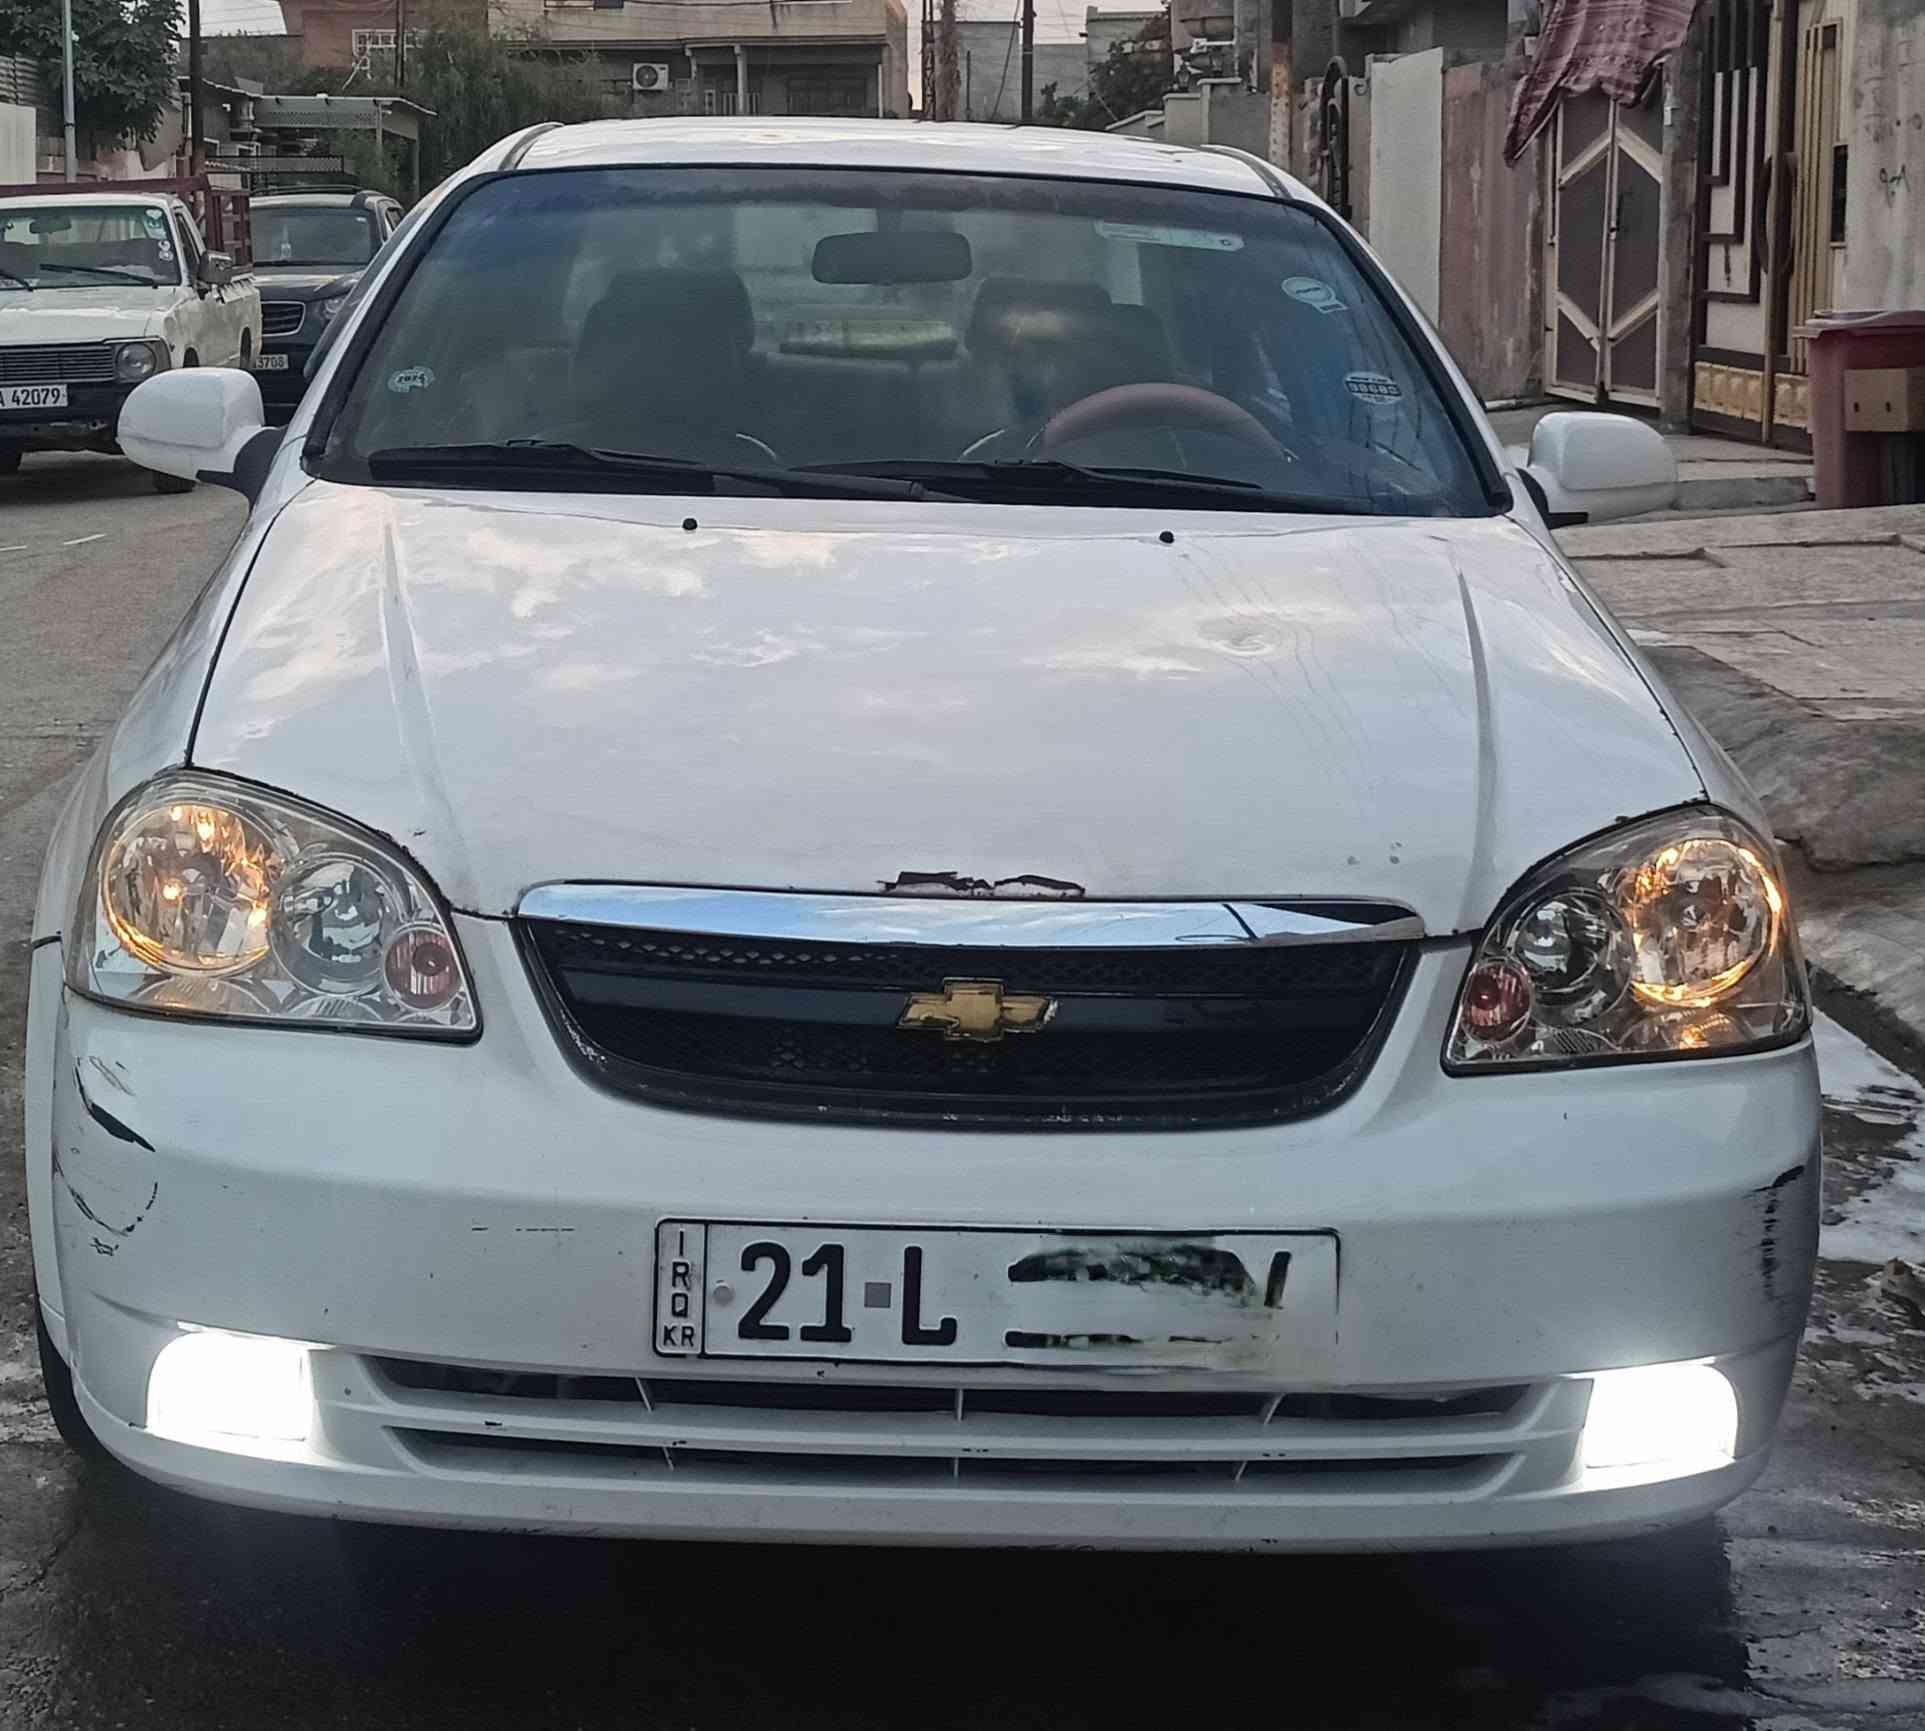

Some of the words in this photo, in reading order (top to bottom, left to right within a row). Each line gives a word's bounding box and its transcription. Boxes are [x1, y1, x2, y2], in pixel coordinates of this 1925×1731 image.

[12, 388, 60, 406] 42079
[902, 1245, 957, 1345] L
[663, 1324, 694, 1347] KR
